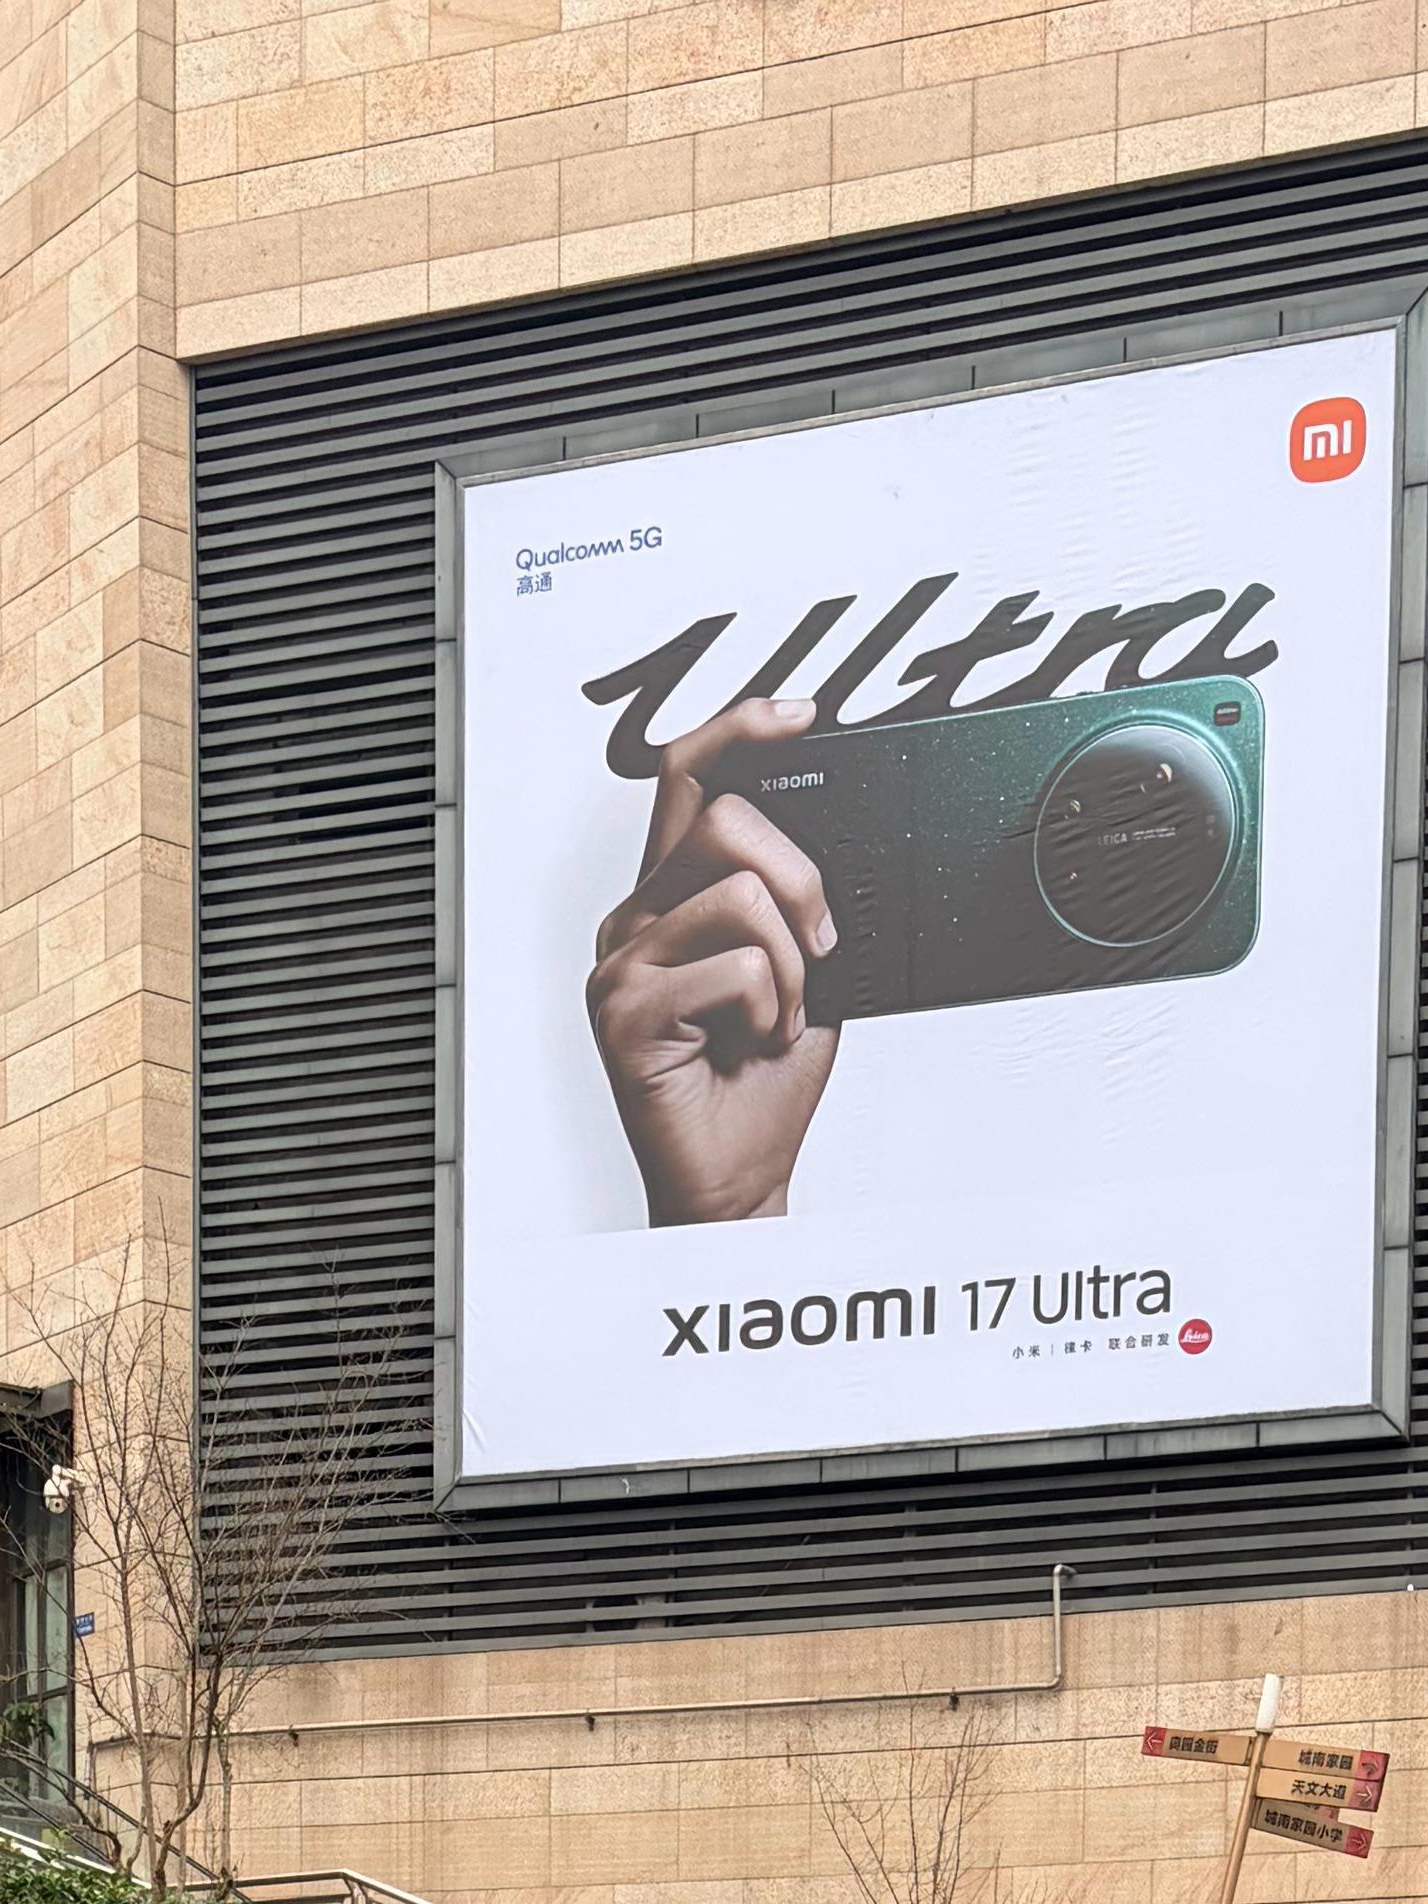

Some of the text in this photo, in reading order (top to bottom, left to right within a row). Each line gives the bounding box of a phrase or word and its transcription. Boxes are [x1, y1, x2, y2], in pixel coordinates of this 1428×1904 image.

[515, 526, 663, 573] Qualcomm 5G
[515, 571, 554, 598] 高通
[581, 571, 1278, 780] Ultra
[761, 770, 824, 792] xiaomi
[662, 1264, 1172, 1357] xiaomi 17 Ultra
[1012, 1345, 1041, 1360] 小米
[1108, 1332, 1170, 1351] 联合研发
[1179, 1328, 1211, 1343] Leica
[1298, 1749, 1353, 1771] 城南家园
[1291, 1780, 1347, 1800] 天文大道
[1264, 1810, 1343, 1843] 城南家园小学
